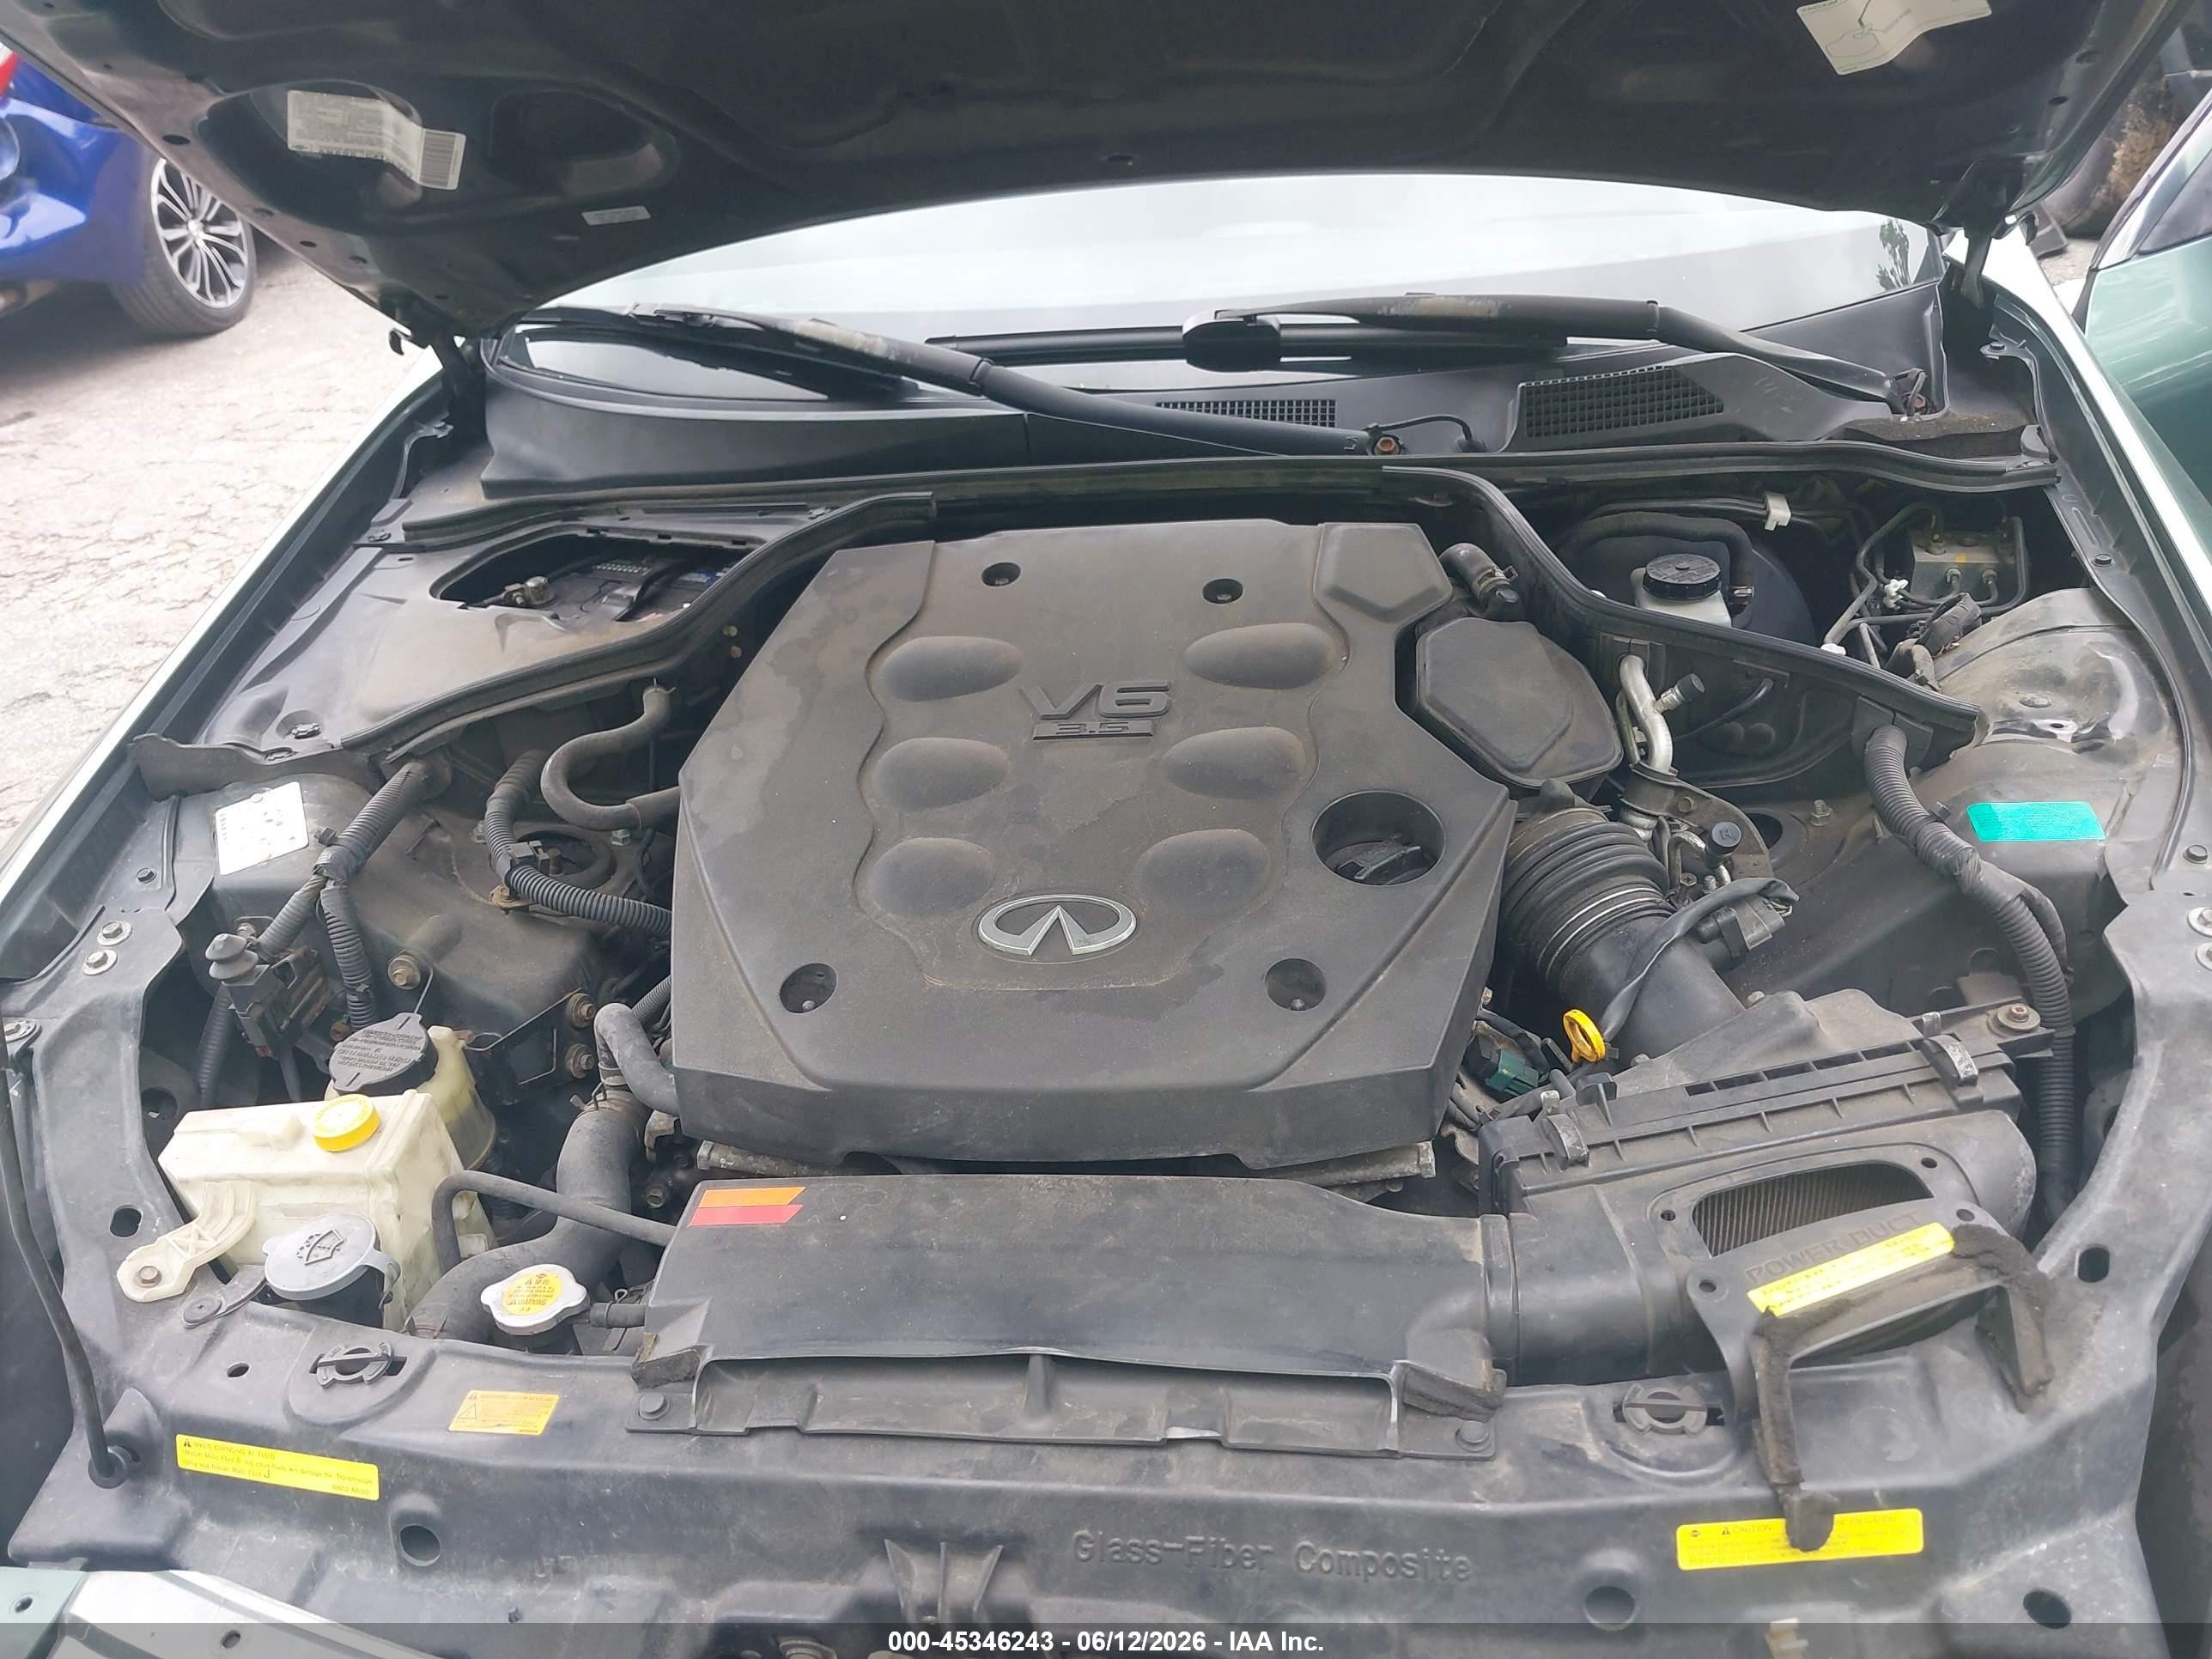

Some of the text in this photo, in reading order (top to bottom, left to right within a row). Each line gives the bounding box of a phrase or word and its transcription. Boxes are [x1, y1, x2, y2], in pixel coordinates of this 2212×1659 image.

[1019, 680, 1170, 720] V6
[1055, 721, 1128, 734] 3.5
[1719, 829, 1732, 840] H
[1745, 1239, 1845, 1284] POWER
[1849, 1209, 1921, 1244] DUCT
[1072, 1530, 1472, 1582] Glass-Fiber Composite
